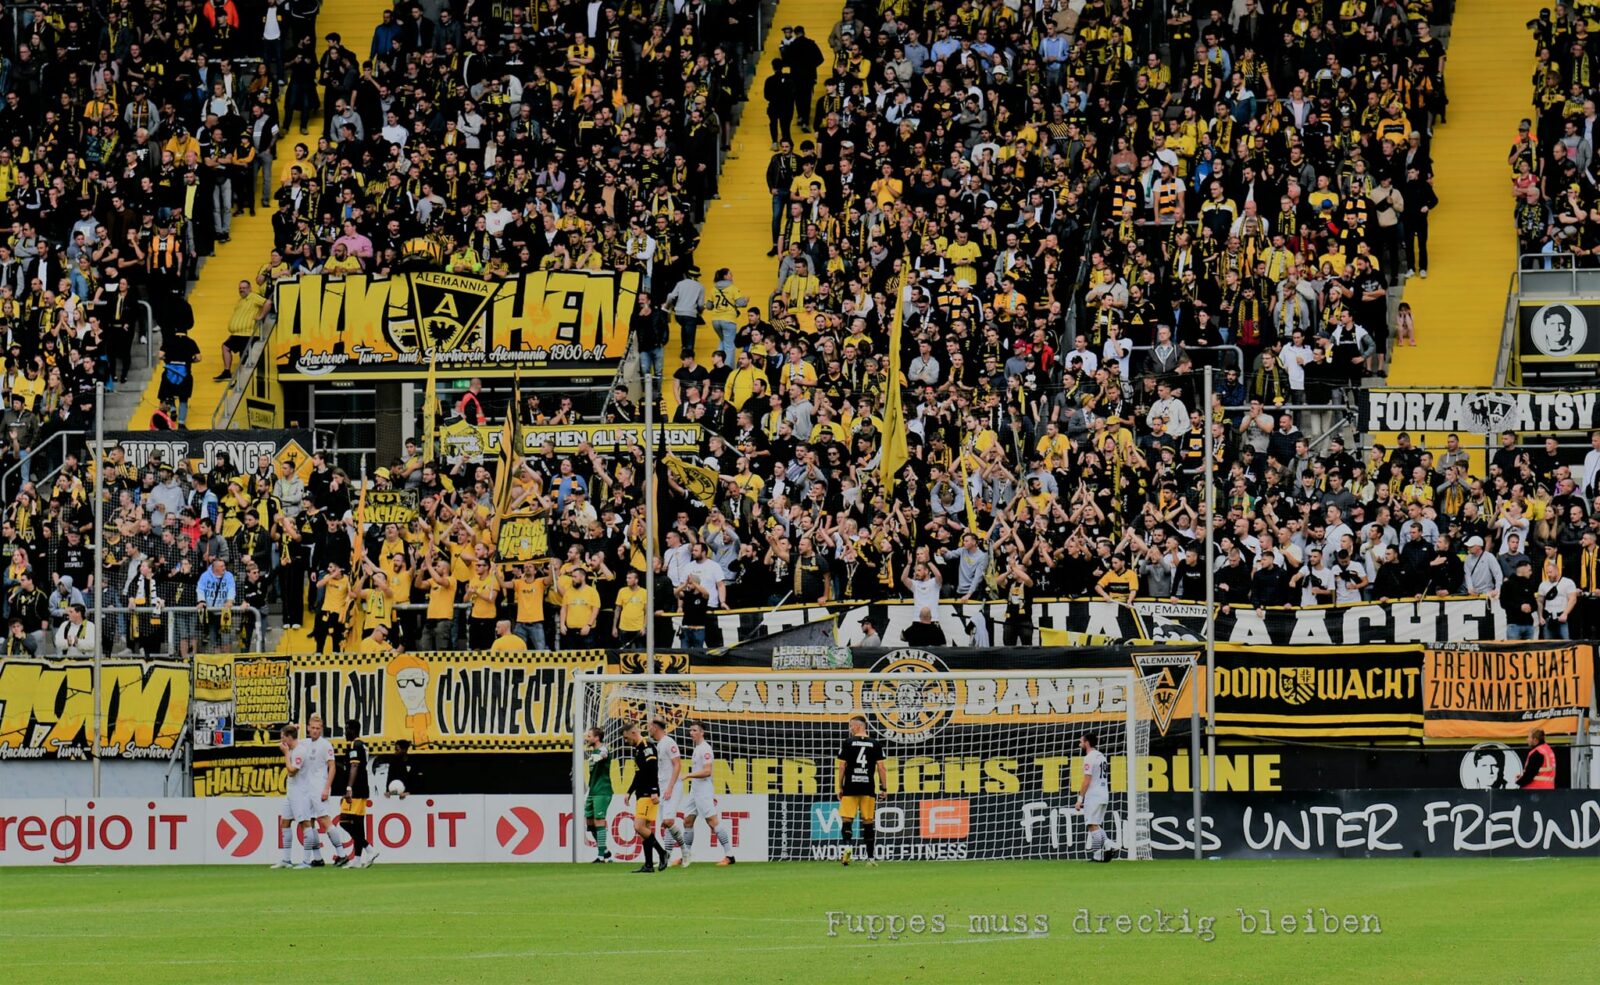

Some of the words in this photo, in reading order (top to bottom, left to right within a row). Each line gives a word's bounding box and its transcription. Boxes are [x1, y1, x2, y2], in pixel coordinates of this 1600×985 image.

[415, 272, 490, 294] ALEMANNIA
[433, 294, 459, 318] A
[300, 350, 349, 366] Aachener
[352, 345, 392, 364] Turn-
[398, 349, 417, 362] und
[488, 344, 547, 362] Alemannia
[549, 344, 583, 360] 1900
[1368, 393, 1464, 431] FORZA
[1514, 393, 1596, 431] ATSV
[886, 650, 937, 665] KARLS
[1139, 656, 1192, 666] ALEMANNIA
[1433, 646, 1579, 681] FREUNDSCHAFT
[236, 662, 287, 679] FREIHEIT
[1157, 667, 1175, 687] A
[1214, 665, 1279, 700] DOM
[1317, 666, 1421, 701] WACHT
[1430, 676, 1581, 711] ZUSAMMENHALT
[694, 680, 856, 714] KARLS
[963, 677, 1128, 717] BANDE
[856, 747, 868, 769] 4
[582, 757, 818, 794] WNER
[1034, 748, 1282, 793] TIBÜNE
[0, 801, 133, 864] regio
[1243, 803, 1403, 851] UNTER
[875, 844, 894, 860] OF
[901, 843, 968, 860] FITNESS
